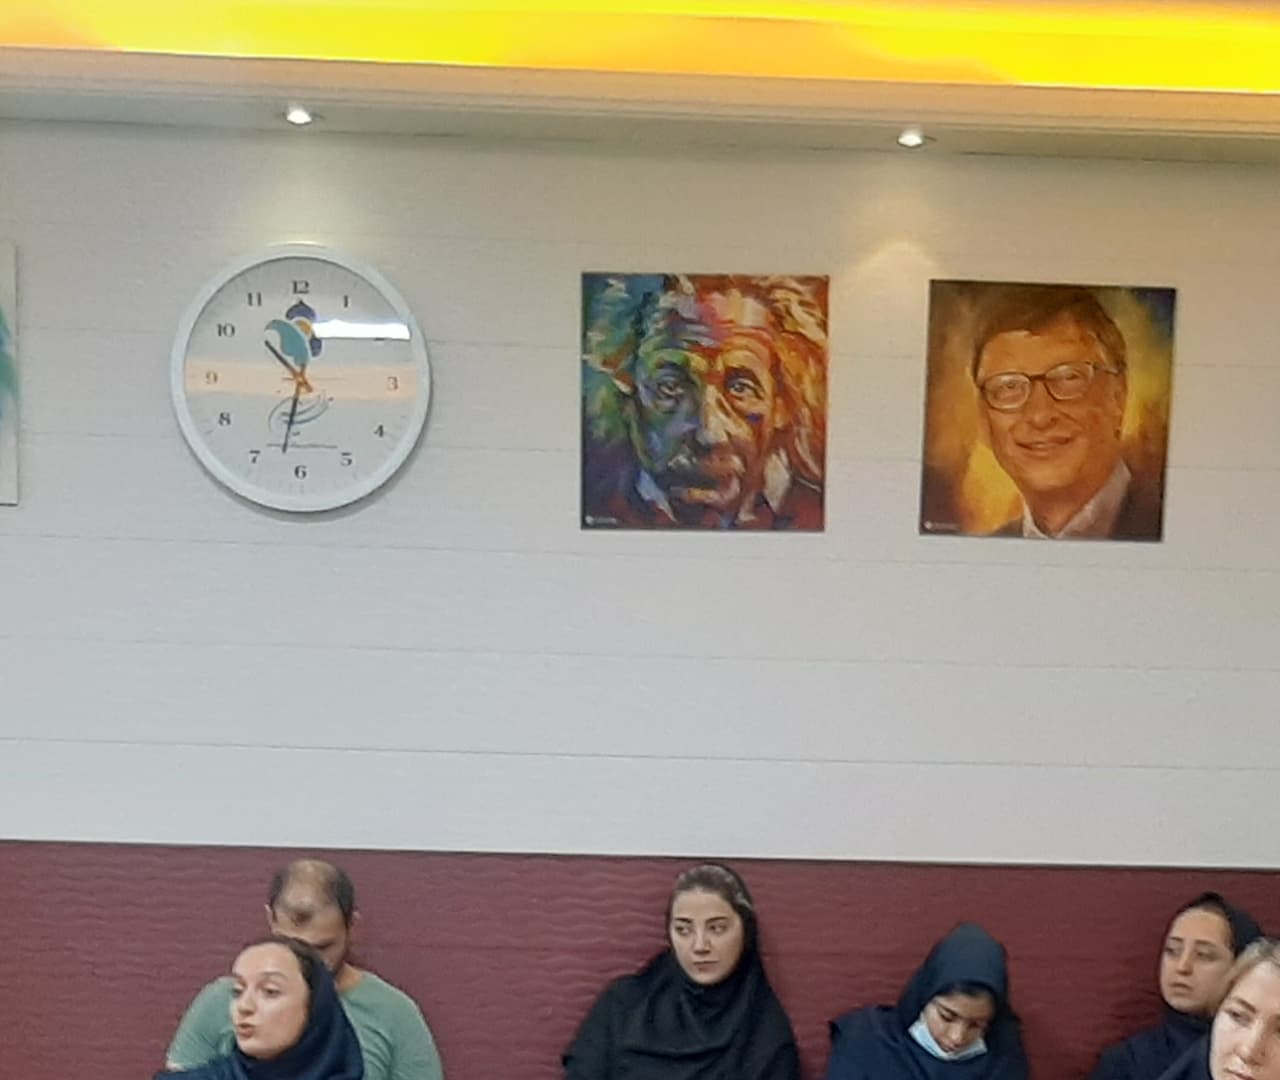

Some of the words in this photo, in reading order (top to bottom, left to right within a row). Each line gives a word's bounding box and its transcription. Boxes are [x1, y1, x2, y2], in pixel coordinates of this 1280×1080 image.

[292, 280, 309, 294] 12
[248, 292, 262, 306] 11
[343, 295, 349, 307] 1
[217, 323, 235, 338] 10
[205, 371, 218, 386] 9
[387, 376, 399, 391] 3
[218, 412, 231, 426] 8
[373, 424, 385, 438] 4
[250, 450, 261, 465] 7
[340, 452, 353, 467] 5
[294, 465, 307, 480] 6
